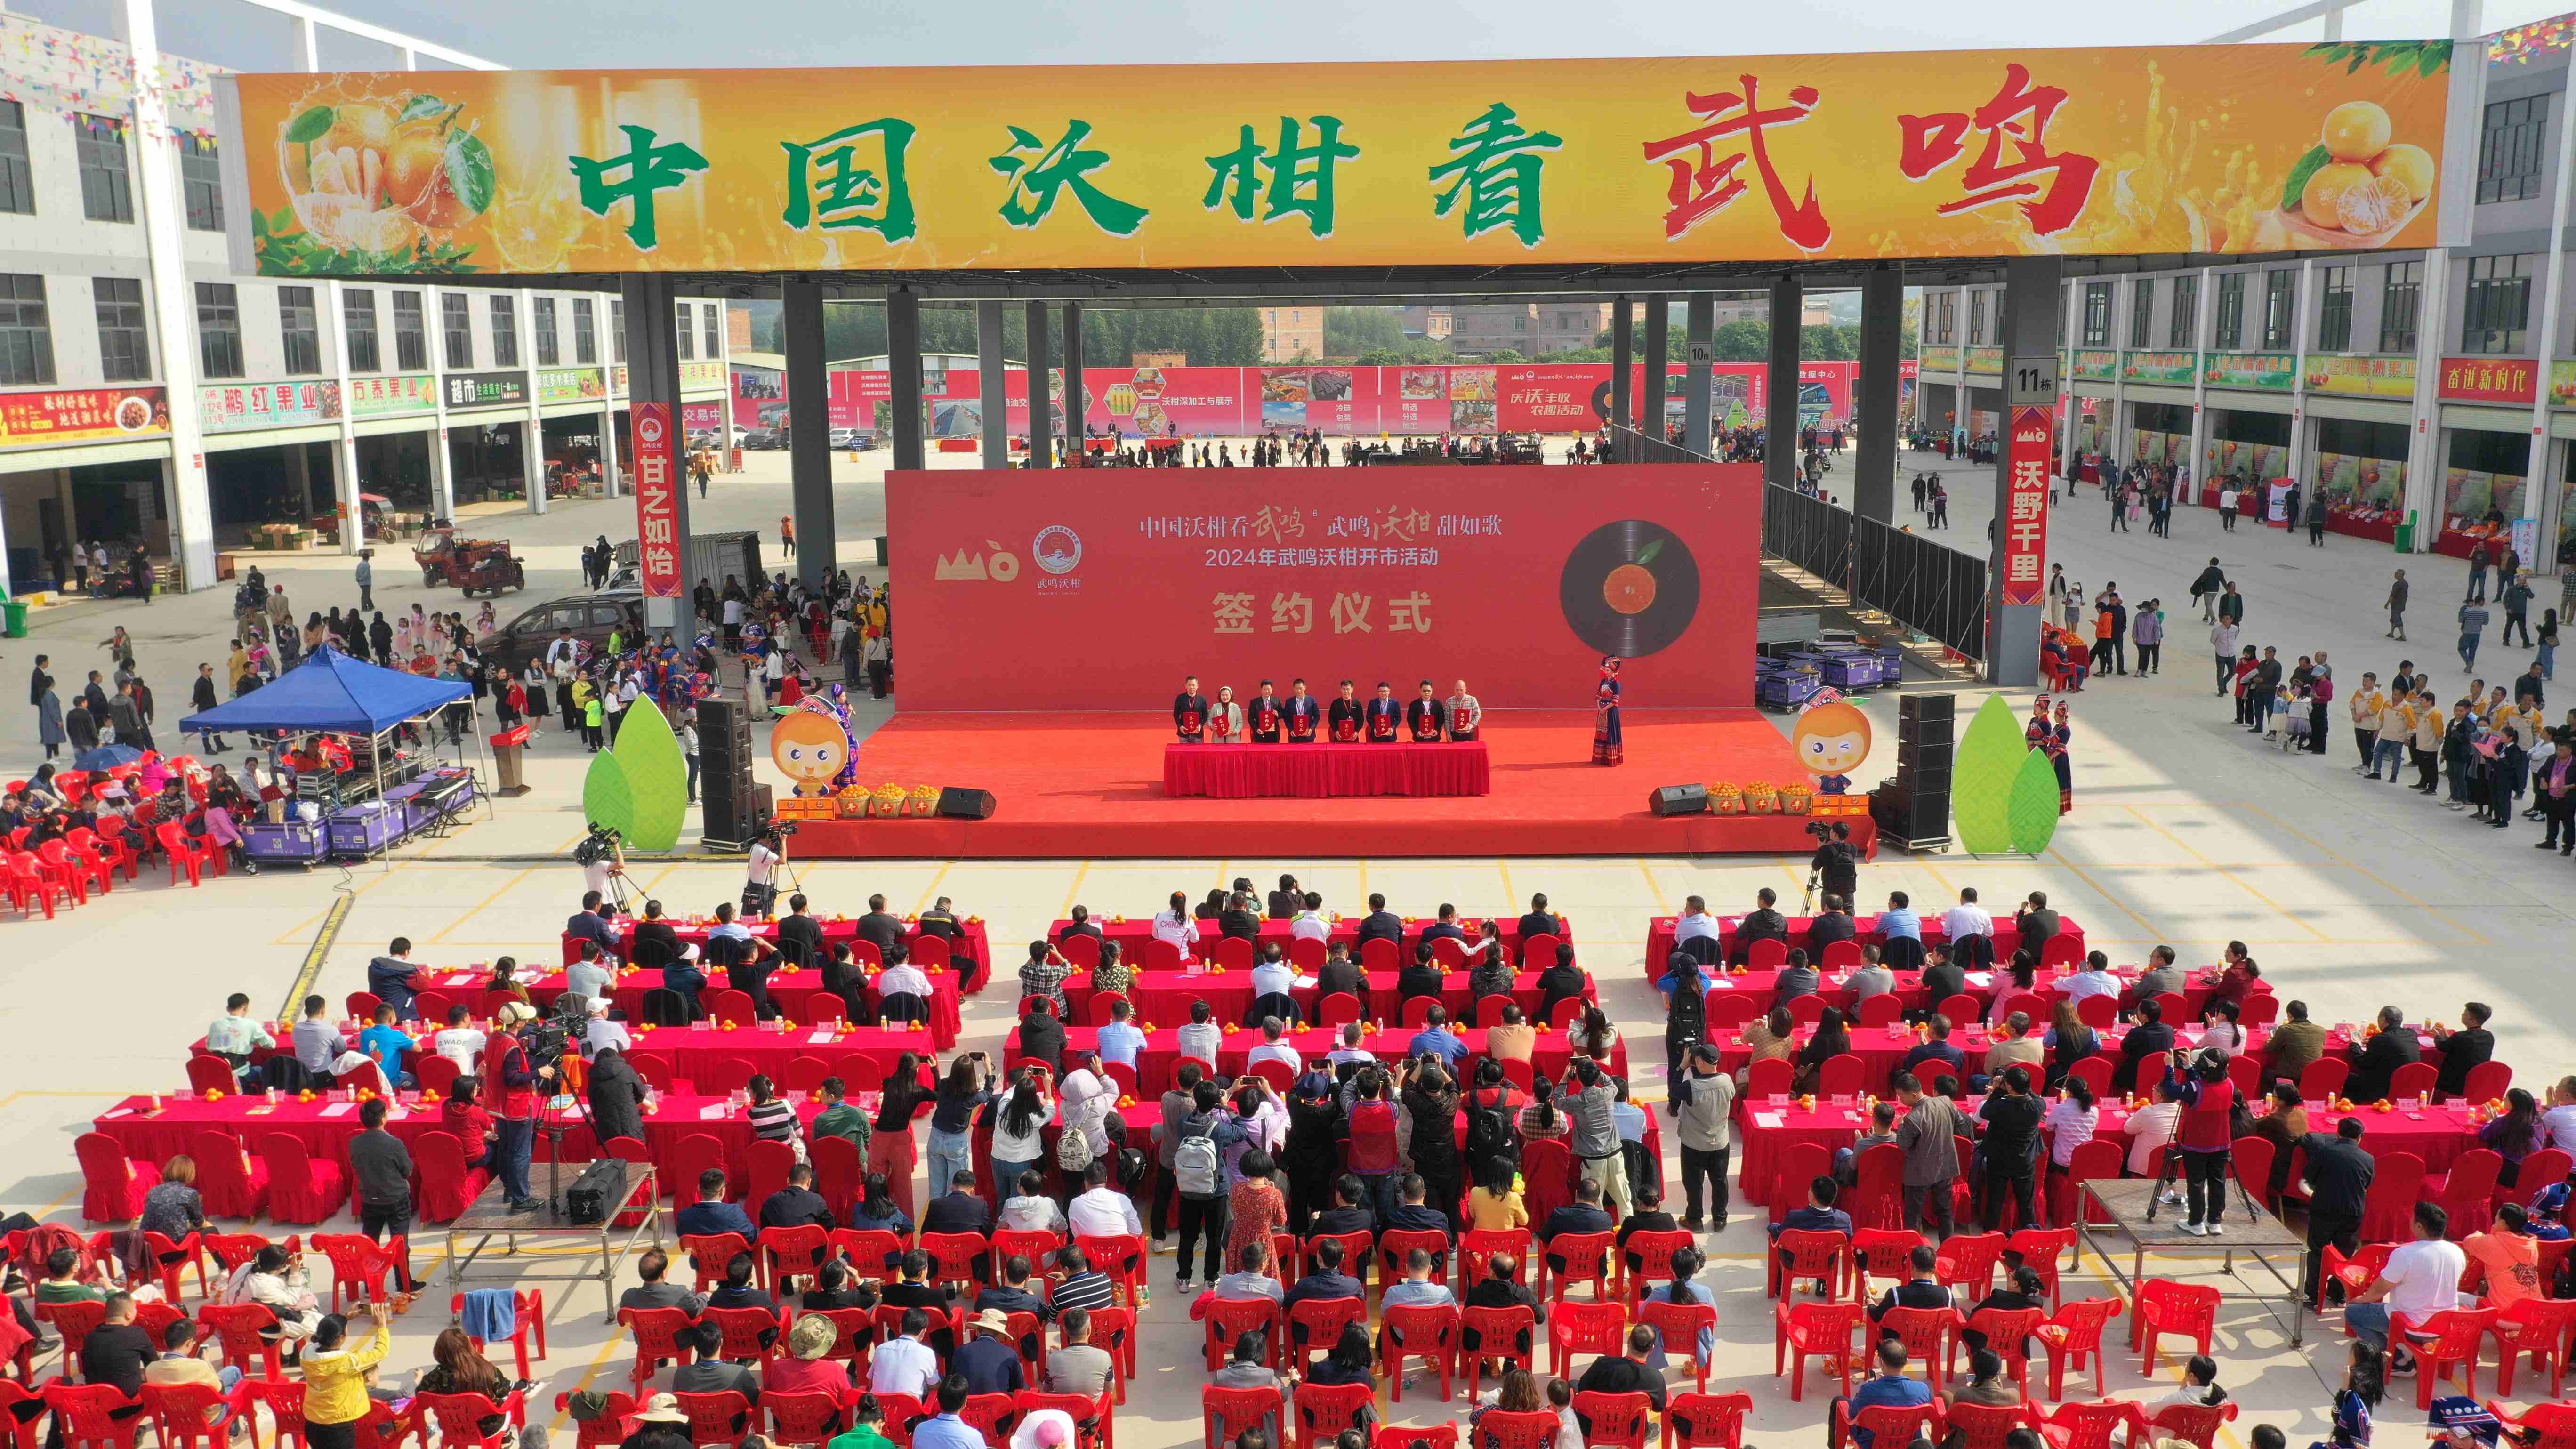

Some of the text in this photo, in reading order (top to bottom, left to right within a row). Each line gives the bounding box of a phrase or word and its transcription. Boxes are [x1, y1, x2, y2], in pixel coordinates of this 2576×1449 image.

[569, 63, 2099, 252] 中国沃柑看武鸣
[1799, 370, 1835, 379] 数据中心
[2017, 368, 2052, 392] 11栋
[2448, 368, 2526, 393] 奋进新时代
[451, 379, 475, 403] 超市
[224, 383, 318, 416] 鹏红果业
[1161, 396, 1233, 406] 沃柑深加工与展示
[1530, 405, 1584, 415] 农趣活动
[640, 455, 674, 576] 甘之如饴
[2010, 460, 2044, 581] 沃野千里
[1139, 504, 1503, 545] 中国沃柑看武鸣 武鸣沃柑甜如歌
[1205, 547, 1439, 566] 2024年武鸣沃柑开市活动
[1038, 578, 1081, 589] 武鸣沃柑
[1212, 591, 1432, 634] 签约仪式
[846, 802, 857, 813] 丰
[881, 802, 892, 814] 丰
[916, 802, 927, 813] 丰
[1721, 799, 1731, 811] 丰
[1756, 798, 1767, 810] 丰
[1792, 799, 1803, 811] 丰
[1160, 920, 1183, 929] CHINA
